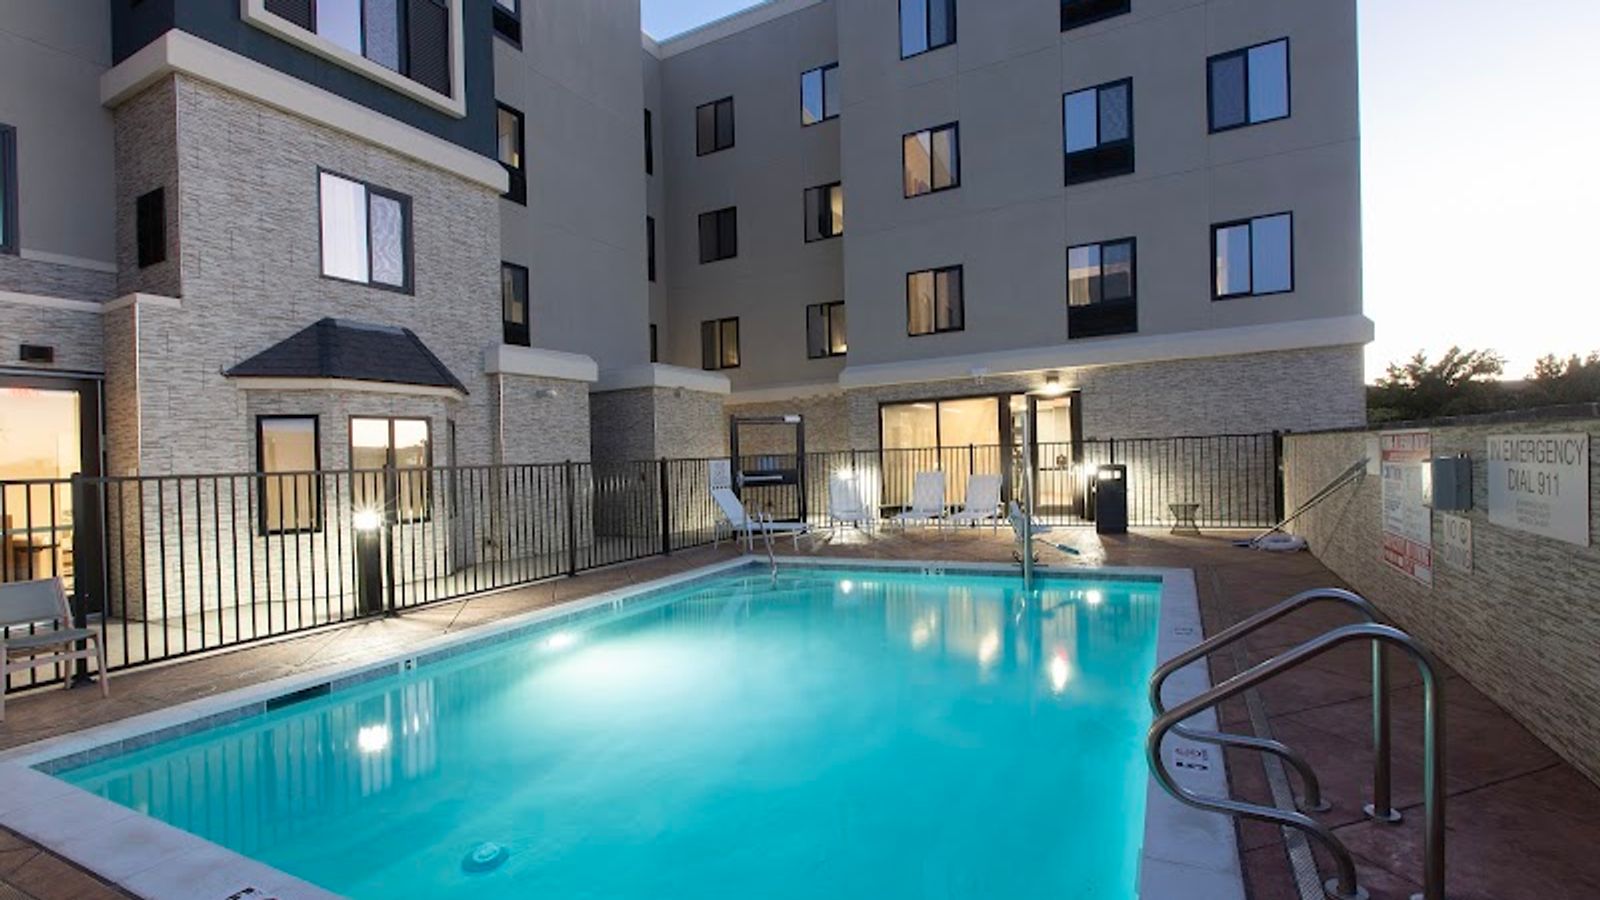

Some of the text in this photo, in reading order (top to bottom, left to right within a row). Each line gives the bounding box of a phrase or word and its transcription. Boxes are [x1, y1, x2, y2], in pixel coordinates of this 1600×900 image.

[1489, 438, 1586, 466] IN EMERGENCY
[1508, 468, 1560, 497] DIAL 911
